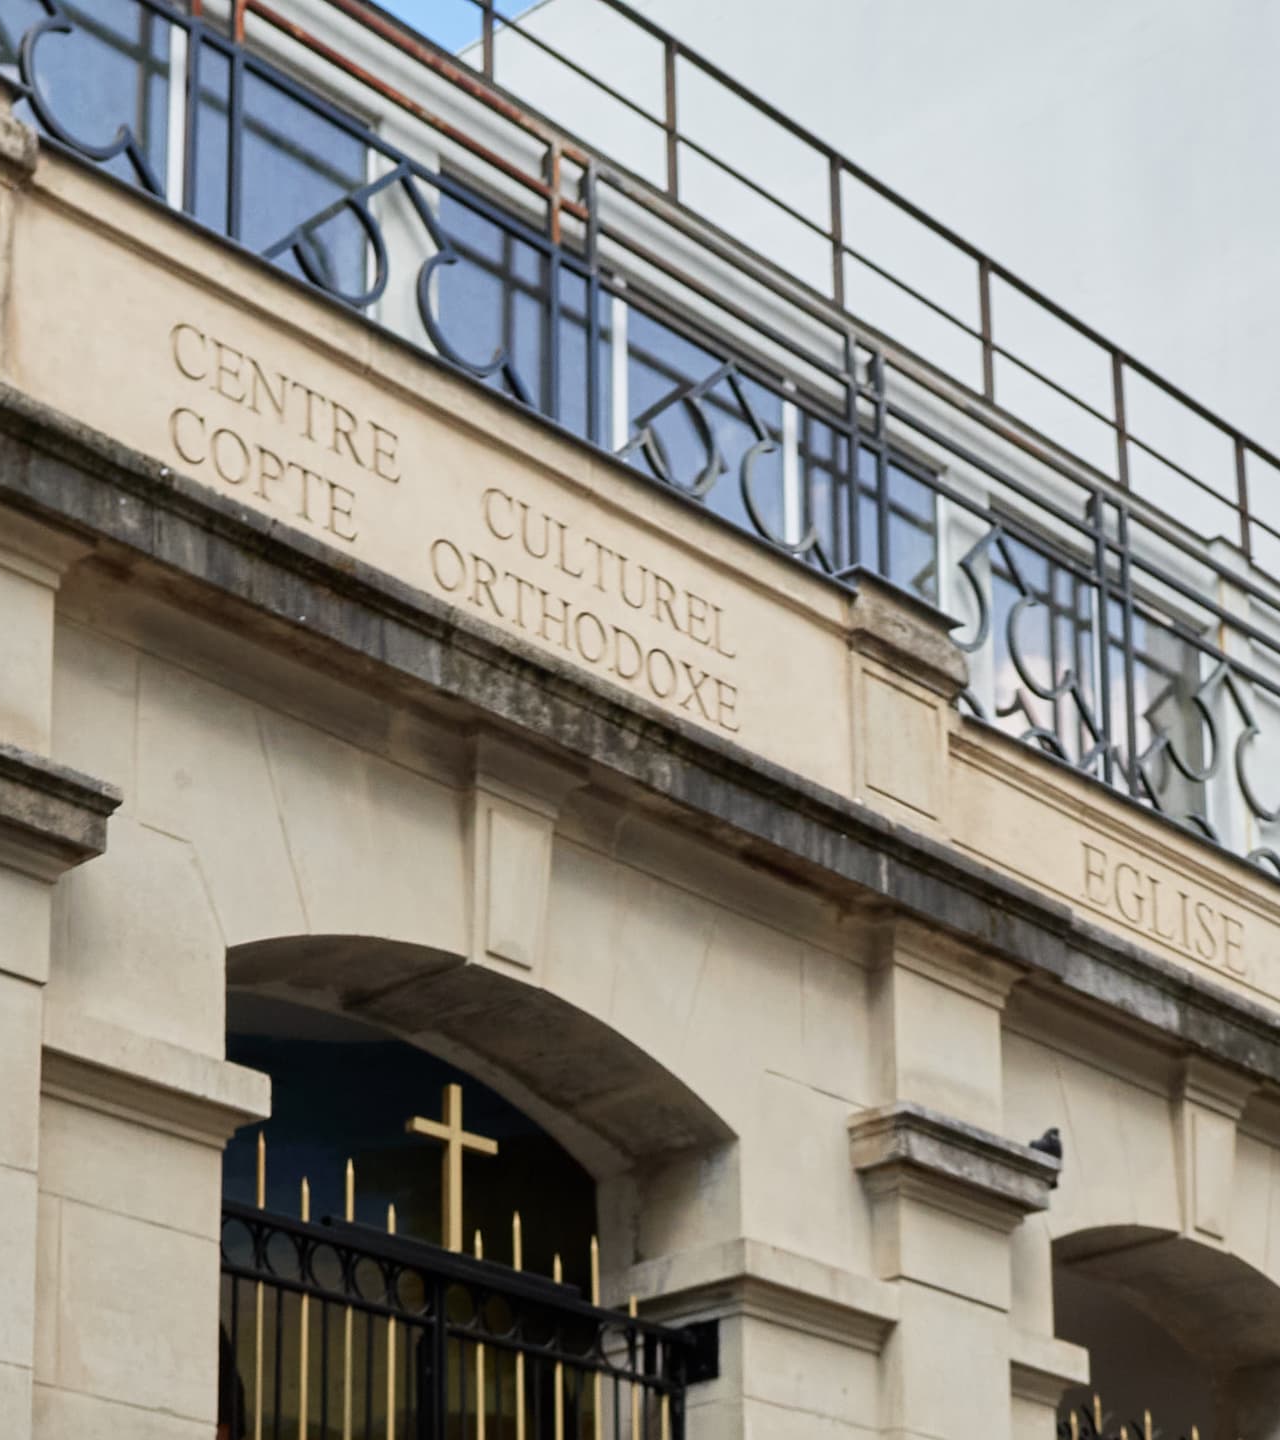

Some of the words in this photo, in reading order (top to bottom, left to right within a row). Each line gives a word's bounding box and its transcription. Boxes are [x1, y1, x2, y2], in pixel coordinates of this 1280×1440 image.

[168, 322, 402, 485] CENTRE
[480, 486, 739, 660] CULTUREL
[168, 406, 360, 544] COPTE
[429, 538, 742, 733] ORTHODOXE
[1080, 841, 1248, 977] EGLISE
